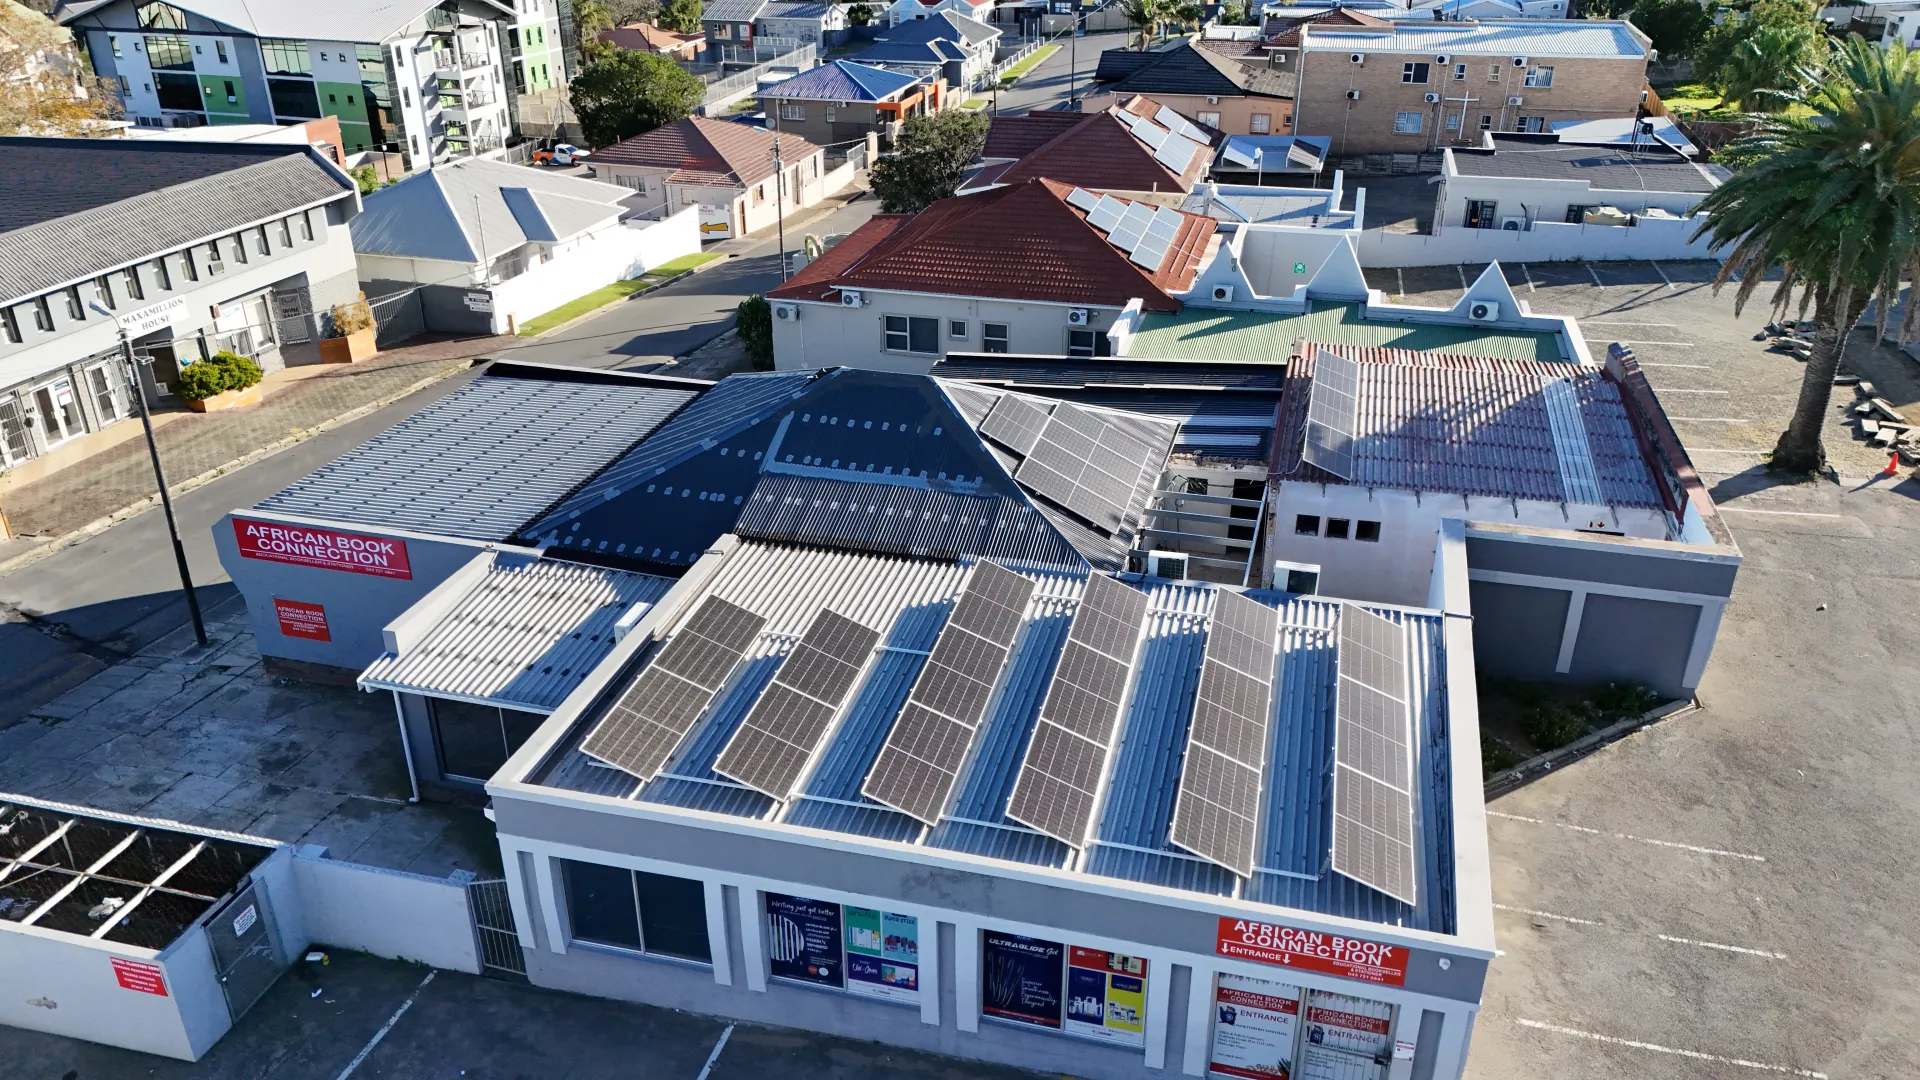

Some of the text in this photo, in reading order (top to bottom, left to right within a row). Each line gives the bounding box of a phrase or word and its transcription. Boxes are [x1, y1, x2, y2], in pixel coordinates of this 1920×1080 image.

[123, 298, 184, 325] MAXAMILLION
[142, 314, 170, 330] HOUSE
[247, 525, 395, 556] AFRICAN BOOK
[257, 538, 388, 567] CONNECTION
[278, 606, 304, 614] AFRICAN
[280, 612, 324, 622] CONNECTION
[772, 900, 795, 912] Writing
[818, 907, 835, 916] better
[989, 938, 1045, 953] ULTRAGLIDE
[1046, 947, 1059, 956] Gel
[1234, 920, 1393, 958] AFRICAN BOOK
[1229, 946, 1281, 961] ENTRANCE
[1242, 932, 1382, 966] CONNECTION
[1332, 961, 1402, 977] EDUCATIONAL BOOKSELLER
[1355, 969, 1383, 977] STATIONER
[1222, 989, 1293, 1006] AFRICAN BOOK
[1230, 995, 1283, 1009] CONNECTION
[1240, 1009, 1289, 1025] ENTRANCE
[1311, 1008, 1383, 1025] AFRICAN BOOK
[1318, 1015, 1373, 1030] CONNECTION
[1328, 1029, 1379, 1044] ENTRANCE
